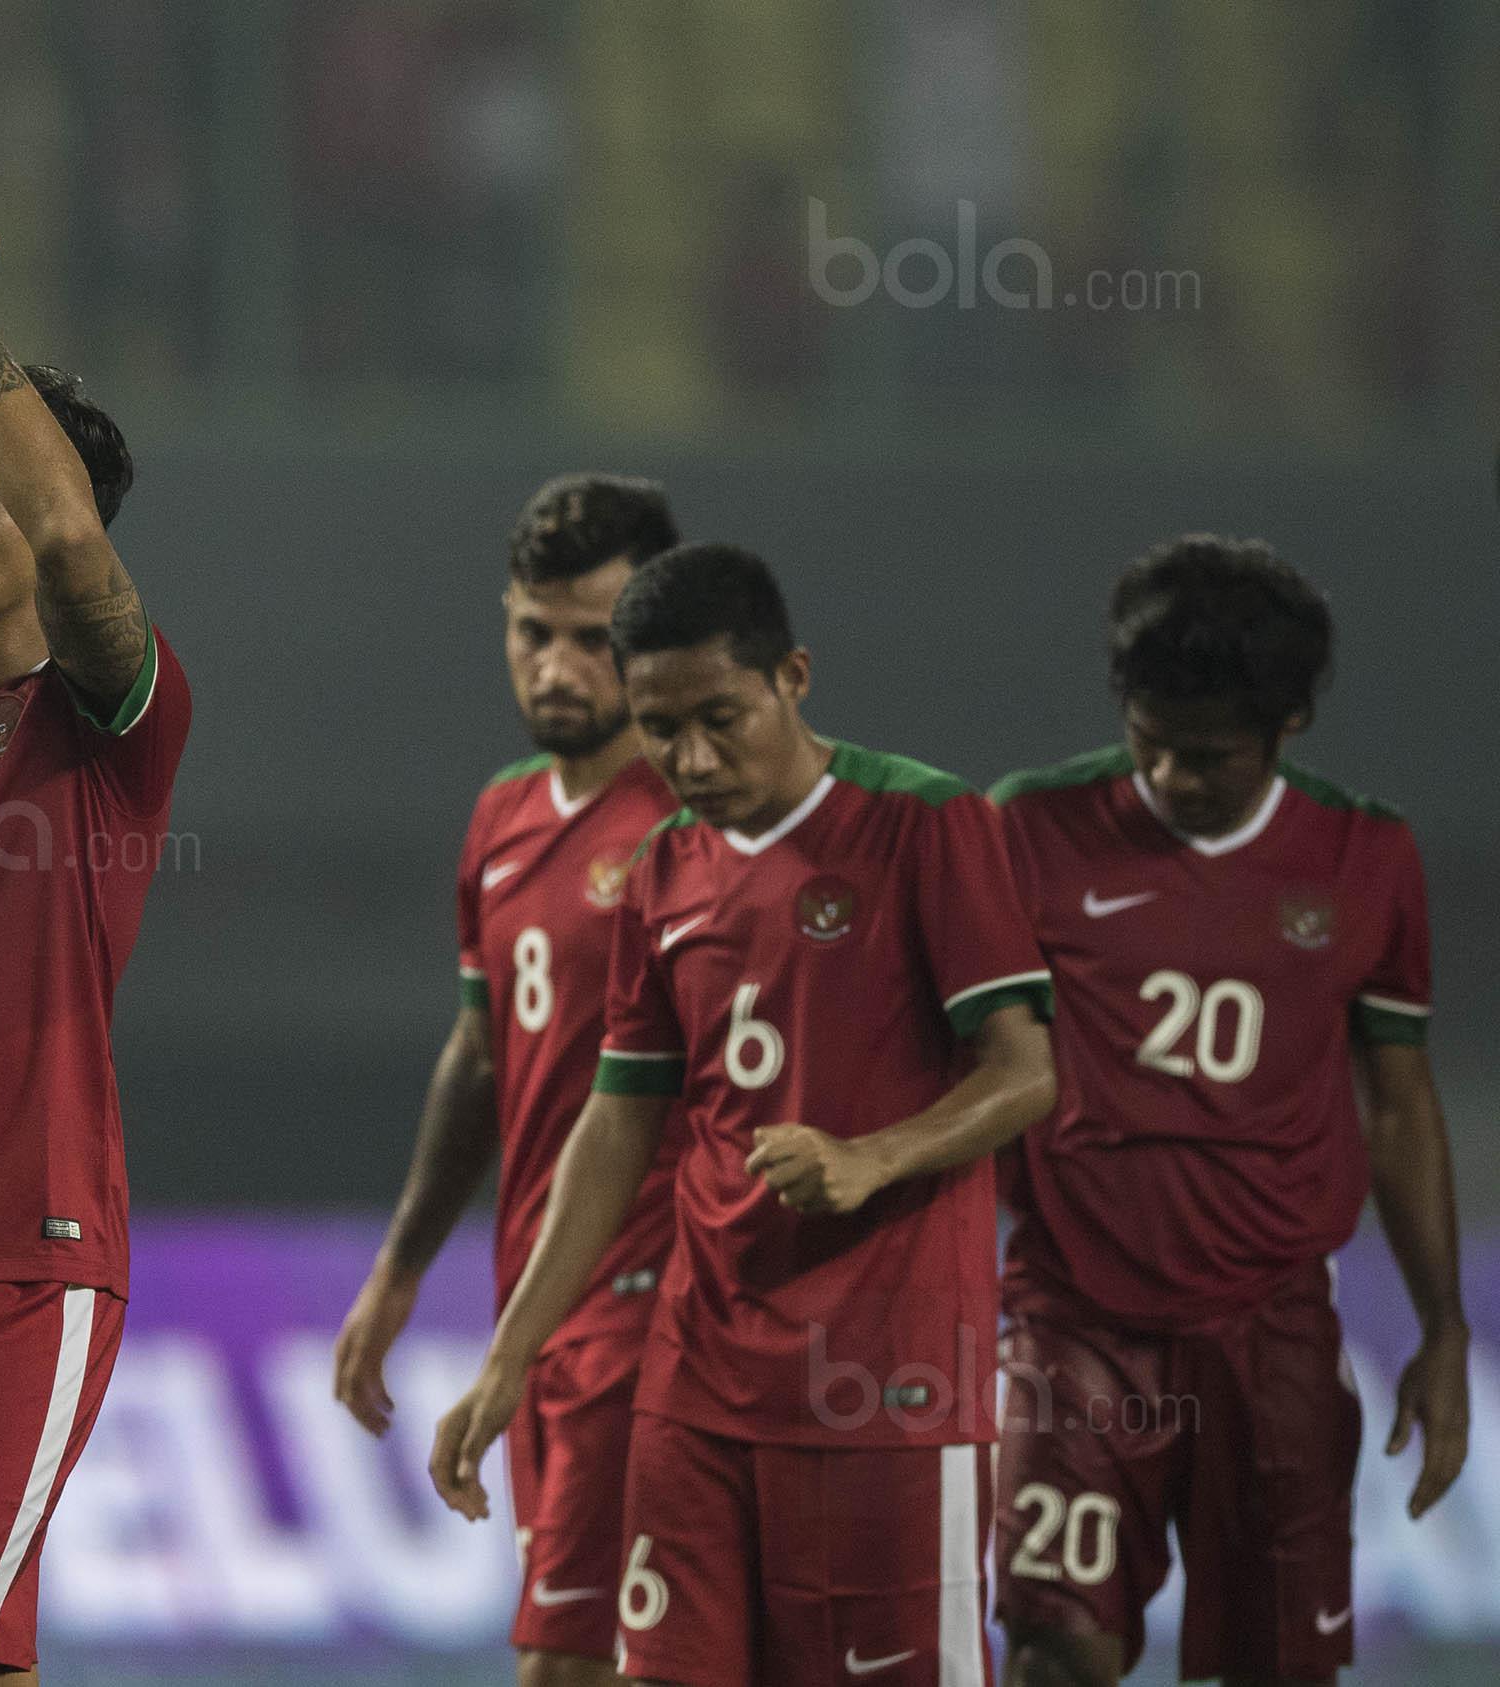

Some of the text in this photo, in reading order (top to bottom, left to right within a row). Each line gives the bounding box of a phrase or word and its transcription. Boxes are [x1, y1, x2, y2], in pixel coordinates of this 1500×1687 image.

[513, 926, 554, 1034] 8
[1136, 969, 1265, 1084] 20
[725, 983, 785, 1090] 6
[618, 1533, 669, 1632] 6
[1009, 1483, 1121, 1586] 20
